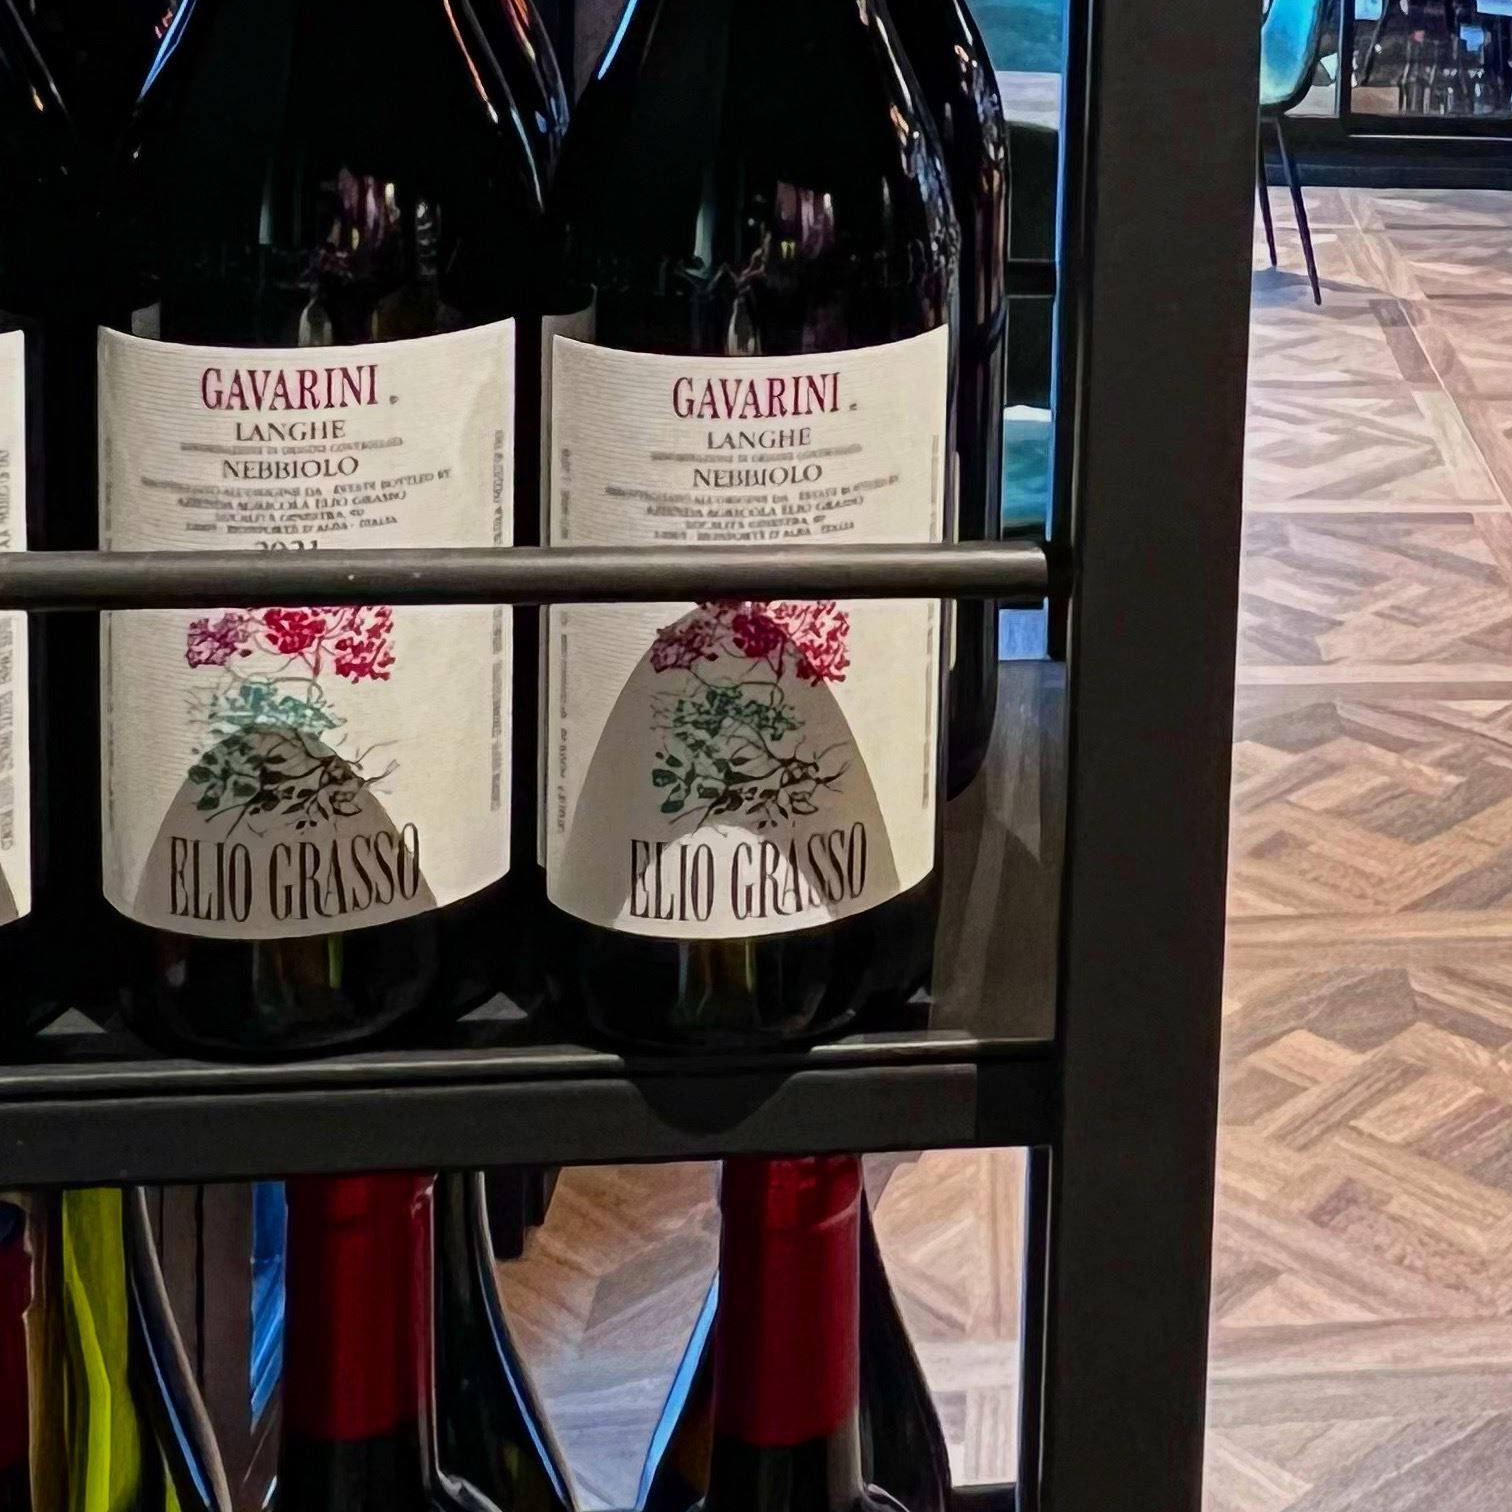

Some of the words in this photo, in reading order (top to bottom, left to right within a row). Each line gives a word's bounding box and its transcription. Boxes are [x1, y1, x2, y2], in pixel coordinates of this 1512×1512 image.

[202, 364, 379, 411] GAVARINI
[673, 371, 841, 419] GAVARINI
[235, 419, 347, 442] LANGHE
[707, 426, 812, 450] LANGHE
[222, 456, 360, 479] NEBBIOLO
[170, 835, 252, 922] ELIO
[268, 822, 421, 921] GRASSO
[630, 839, 715, 922] ELIO
[731, 822, 868, 921] GRASSO
